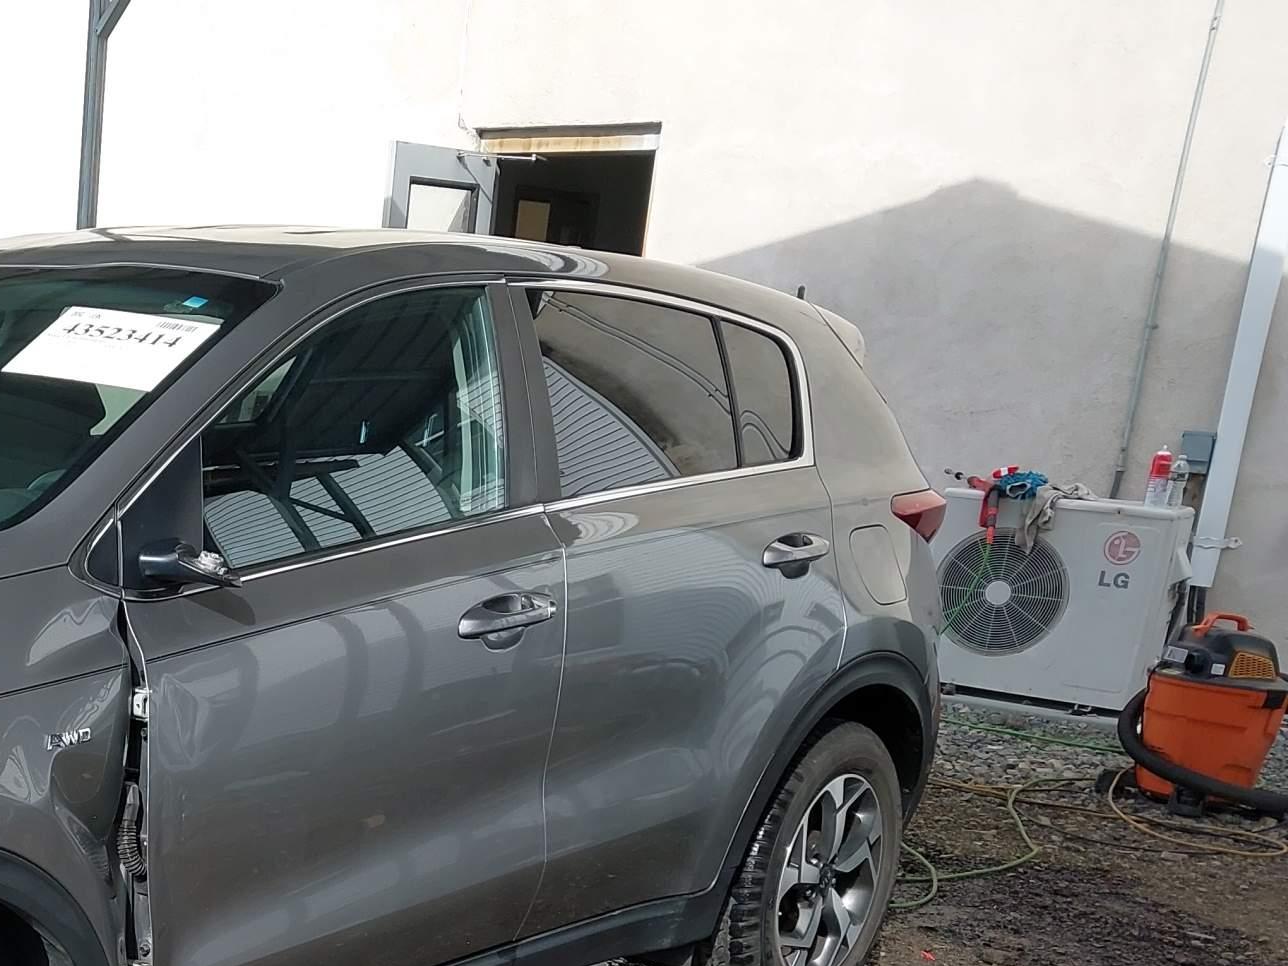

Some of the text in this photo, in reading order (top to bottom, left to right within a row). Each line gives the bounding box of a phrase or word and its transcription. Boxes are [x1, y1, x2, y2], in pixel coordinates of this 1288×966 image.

[62, 321, 183, 348] 43523414
[1098, 570, 1130, 589] LG
[46, 727, 91, 751] AWD
